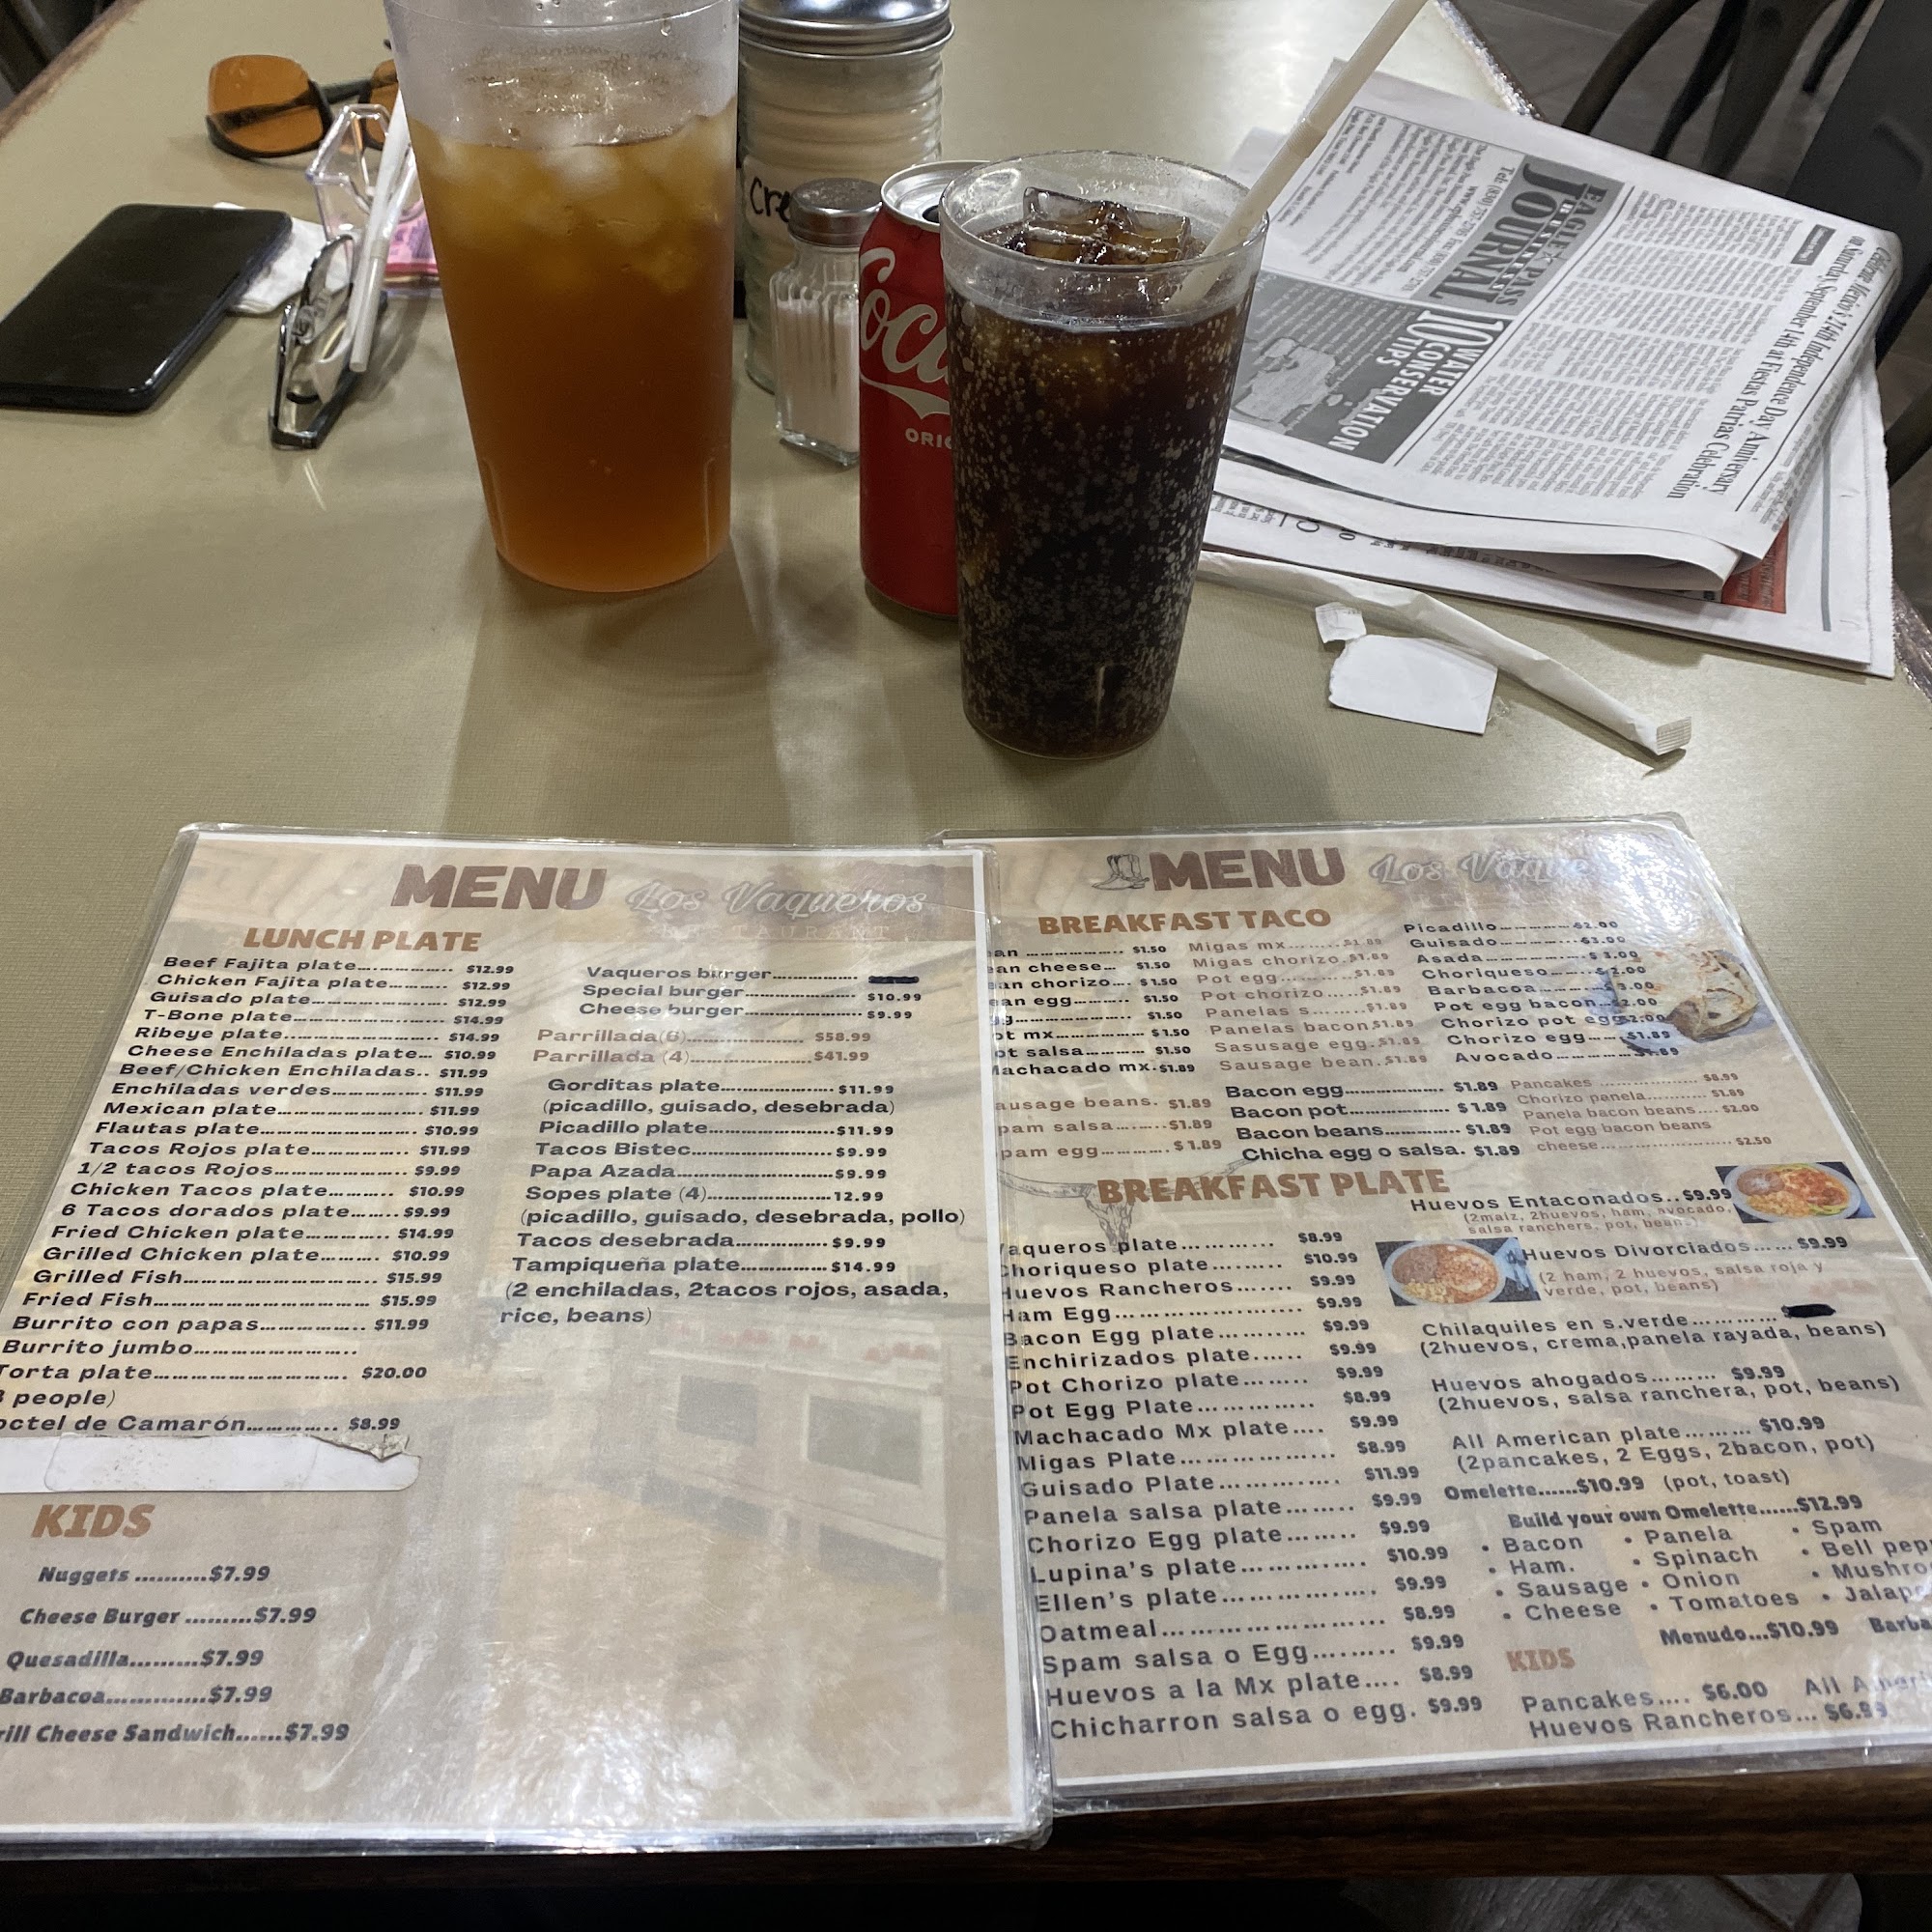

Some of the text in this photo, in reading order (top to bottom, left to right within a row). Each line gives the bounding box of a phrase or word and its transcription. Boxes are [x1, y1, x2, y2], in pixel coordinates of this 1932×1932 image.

[1430, 164, 1588, 303] JOURNAL
[1492, 203, 1574, 290] BUSINESS
[1496, 185, 1607, 305] EAGLE PASS
[1789, 282, 1837, 328] September
[1406, 310, 1504, 346] 10
[1376, 336, 1425, 367] TIPS
[1772, 328, 1804, 355] 14th
[1418, 348, 1484, 396] WATER
[1741, 359, 1783, 398] Fiestas
[1768, 338, 1833, 410] Independence
[1328, 342, 1452, 451] CONSERVATION
[1714, 396, 1760, 440] Patrias
[1749, 400, 1787, 435] Day
[1666, 442, 1729, 499] Celebration
[1706, 431, 1770, 496] Anniversary
[1149, 846, 1347, 892] MENU
[389, 864, 608, 911] MENU
[626, 879, 927, 920] Los Vaqueros
[1037, 908, 1332, 935] BREAKFAST TACO
[242, 926, 483, 952] LUNCH PLATE
[1188, 941, 1249, 954] Migas
[1132, 945, 1167, 954] $1.50
[162, 956, 515, 975] Beef Fajita $12.99
[156, 974, 247, 986] Chicken
[150, 990, 242, 1004] Guisado
[582, 983, 922, 1003] Special $10.99
[1143, 994, 1179, 1004] $1.50
[144, 1009, 504, 1026] T-Bone $14.99
[134, 1026, 213, 1041] Ribeye
[1208, 1022, 1295, 1036] Panelas
[128, 1044, 497, 1061] Cheese Enchiladas $10.99
[532, 1049, 869, 1064] Parrillada $41.99
[1214, 1039, 1320, 1054] Sasusage
[119, 1063, 280, 1079] Beef/Chicken
[111, 1082, 241, 1095] Enchiladas
[548, 1077, 654, 1092] Gorditas
[1225, 1086, 1297, 1098] Bacon
[102, 1101, 480, 1117] Mexican $11.99
[543, 1098, 895, 1116] (picadillo, guisado, desebrada)
[1522, 1107, 1640, 1122] Panela bacon
[95, 1121, 187, 1135] Flautas
[1530, 1119, 1712, 1137] Pot egg bacon beans
[89, 1141, 237, 1158] Tacos Rojos
[1473, 1144, 1520, 1158] $1.89
[1735, 1136, 1773, 1147] $2.50
[1241, 1146, 1324, 1163] Chicha
[70, 1181, 253, 1197] Chicken Tacos
[525, 1185, 672, 1204] Sopes plate
[1097, 1169, 1450, 1205] BREAKFAST PLATE
[86, 1203, 274, 1218] Tacos dorados
[1409, 1198, 1500, 1212] Huevos
[521, 1208, 965, 1228] (picadillo, guisado, desebrada, pollo)
[50, 1224, 229, 1239] Fried Chicken
[1796, 1236, 1849, 1251] $9.99
[43, 1246, 450, 1263] Grilled Chicken $10.99
[511, 1256, 896, 1276] Tampiqueña $14.99
[505, 1280, 949, 1301] (2 enchiladas, 2tacos rojos, asada,
[1543, 1278, 1719, 1297] verde, pot, beans)
[12, 1315, 430, 1332] Burrito con $11.99
[499, 1306, 652, 1326] rice, beans)
[1422, 1319, 1557, 1338] Chilaquiles
[1420, 1340, 1538, 1359] (2huevos,
[1008, 1349, 1177, 1371] Enchirizados
[361, 1365, 428, 1380] $20.00
[1431, 1365, 1786, 1393] Huevos $9.99
[1062, 1375, 1164, 1394] Chorizo
[12, 1389, 116, 1409] people)
[1437, 1375, 1900, 1415] (2huevos, salsa ranchera, pot, beans)
[1012, 1423, 1212, 1447] Machacado Mx
[1452, 1415, 1826, 1451] All American $10.99
[1457, 1433, 1875, 1475] (2pancakes, Eggs, 2bacon, pot)
[1662, 1467, 1790, 1493] (pot, toast)
[30, 1503, 156, 1539] KIDS
[1507, 1509, 1662, 1529] Build your own
[1501, 1519, 1883, 1554] Bacon Panela Spam
[1653, 1545, 1759, 1571] Spinach
[37, 1566, 130, 1587] Nuggets
[1029, 1560, 1154, 1591] Lupina's
[1662, 1570, 1741, 1590] Onion
[1524, 1592, 1800, 1622] Cheese Tomatoes
[19, 1607, 182, 1629] Cheese Burger
[1042, 1655, 1122, 1679] Spam
[1505, 1646, 1577, 1673] KIDS
[1049, 1695, 1483, 1741] Chicharron $9.99
